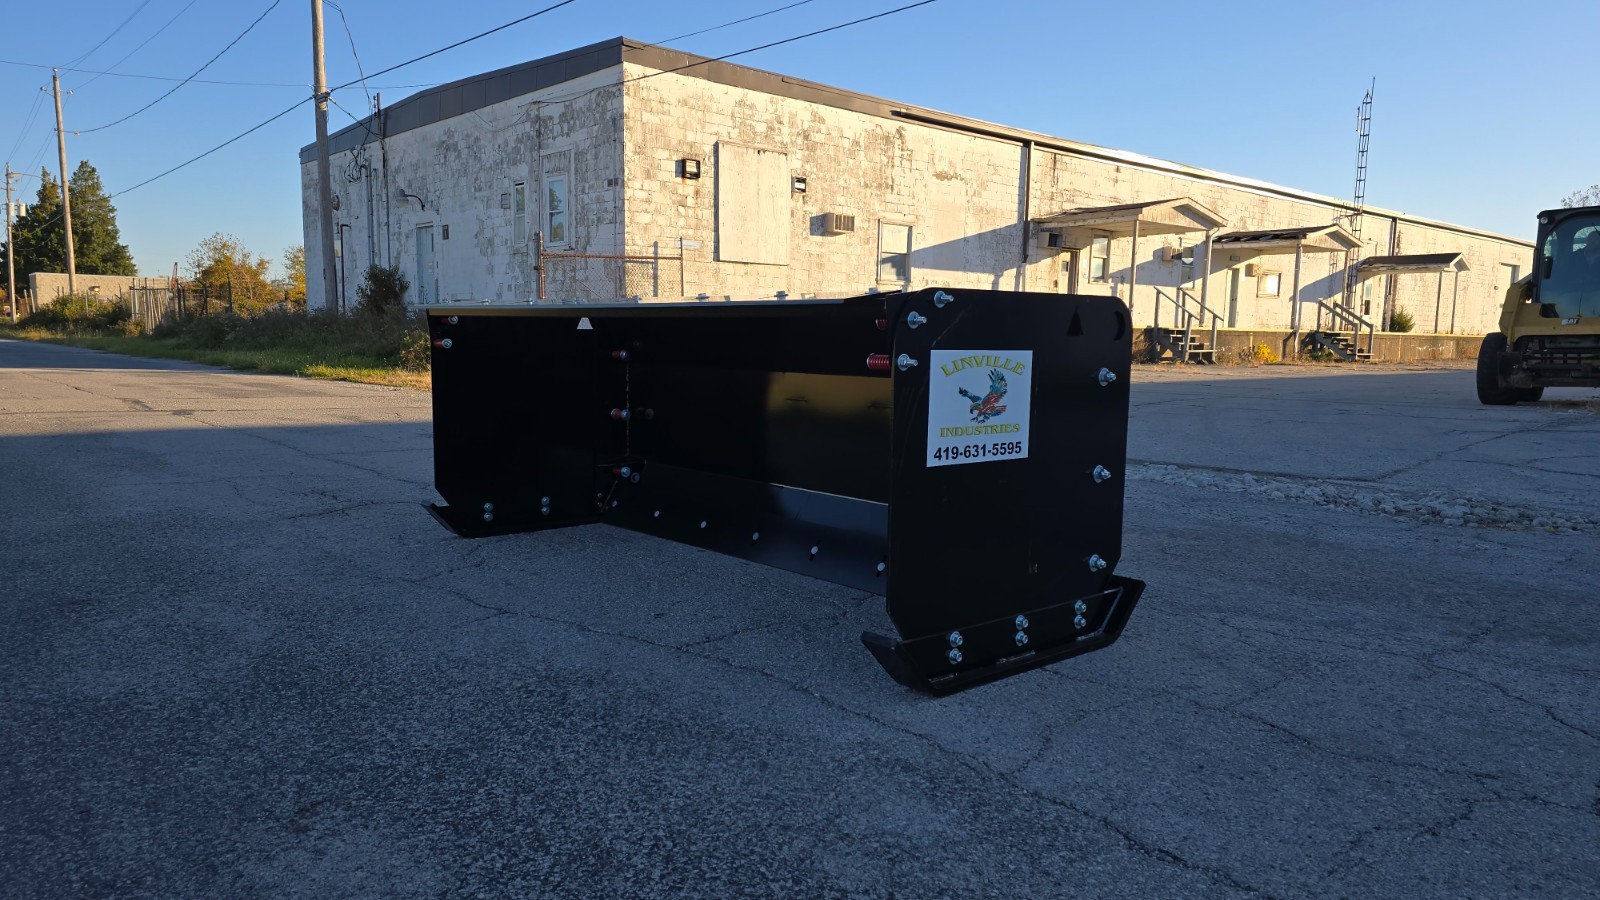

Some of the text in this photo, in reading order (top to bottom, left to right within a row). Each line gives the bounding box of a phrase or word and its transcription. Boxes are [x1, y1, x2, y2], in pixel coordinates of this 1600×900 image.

[940, 355, 1026, 377] LINVILLE
[940, 423, 1020, 437] INDUSTRIES
[933, 441, 1022, 460] 419-631-5595
